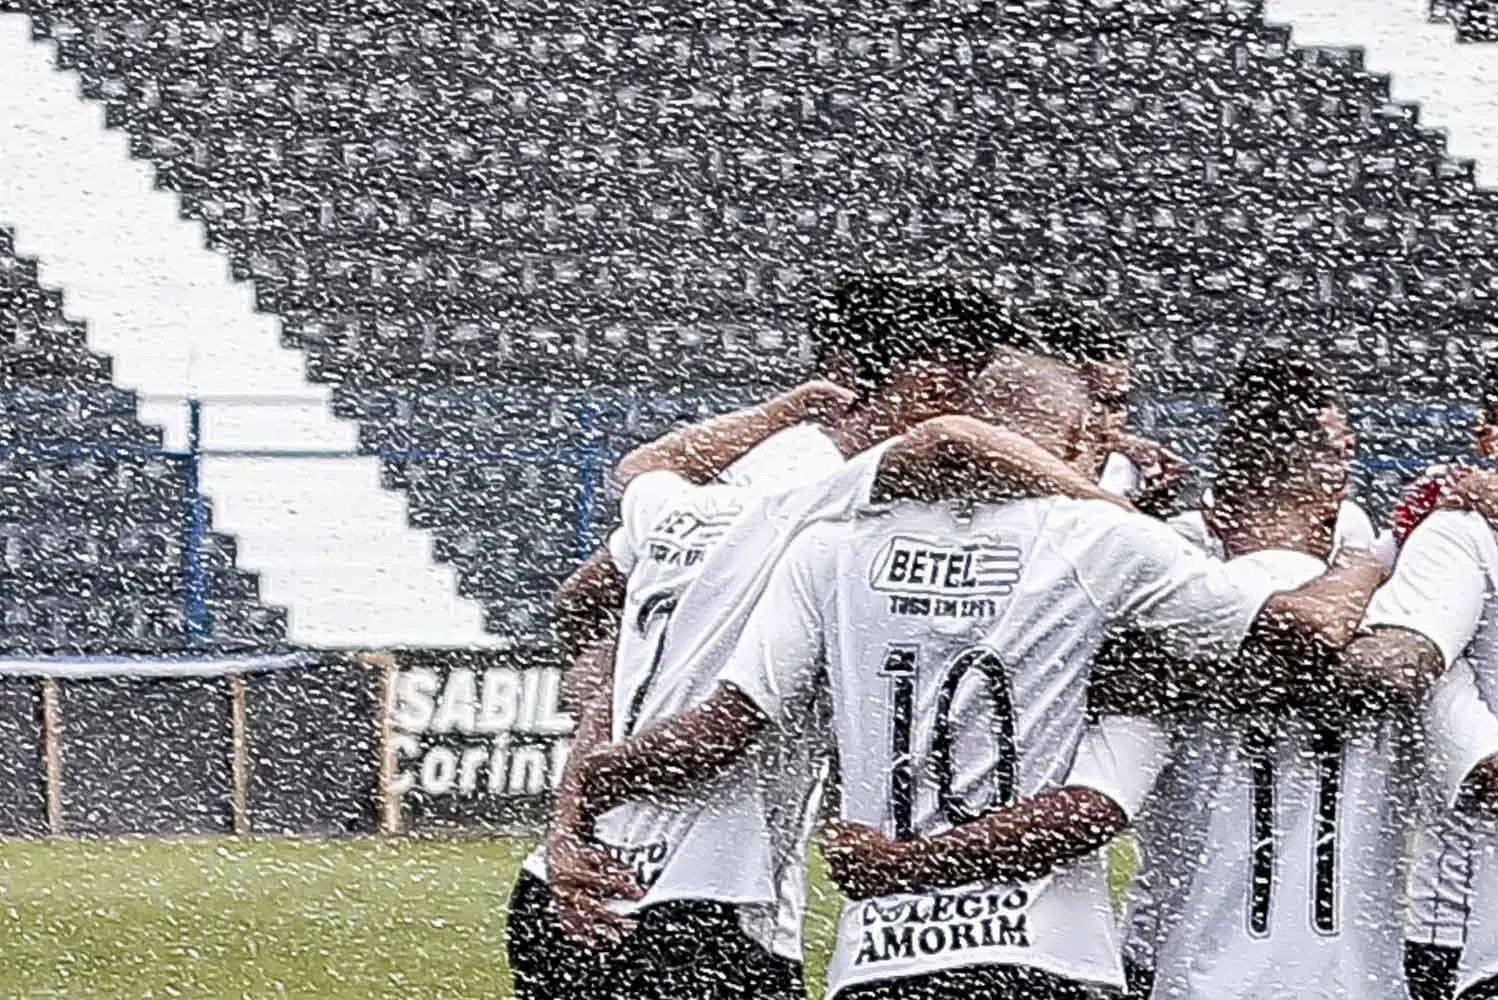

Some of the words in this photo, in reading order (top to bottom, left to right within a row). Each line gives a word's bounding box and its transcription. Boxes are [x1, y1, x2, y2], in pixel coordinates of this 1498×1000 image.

[888, 549, 977, 588] BETEL
[878, 644, 1018, 840] 10
[1243, 728, 1343, 936] 11
[855, 914, 1030, 966] AMORIM
